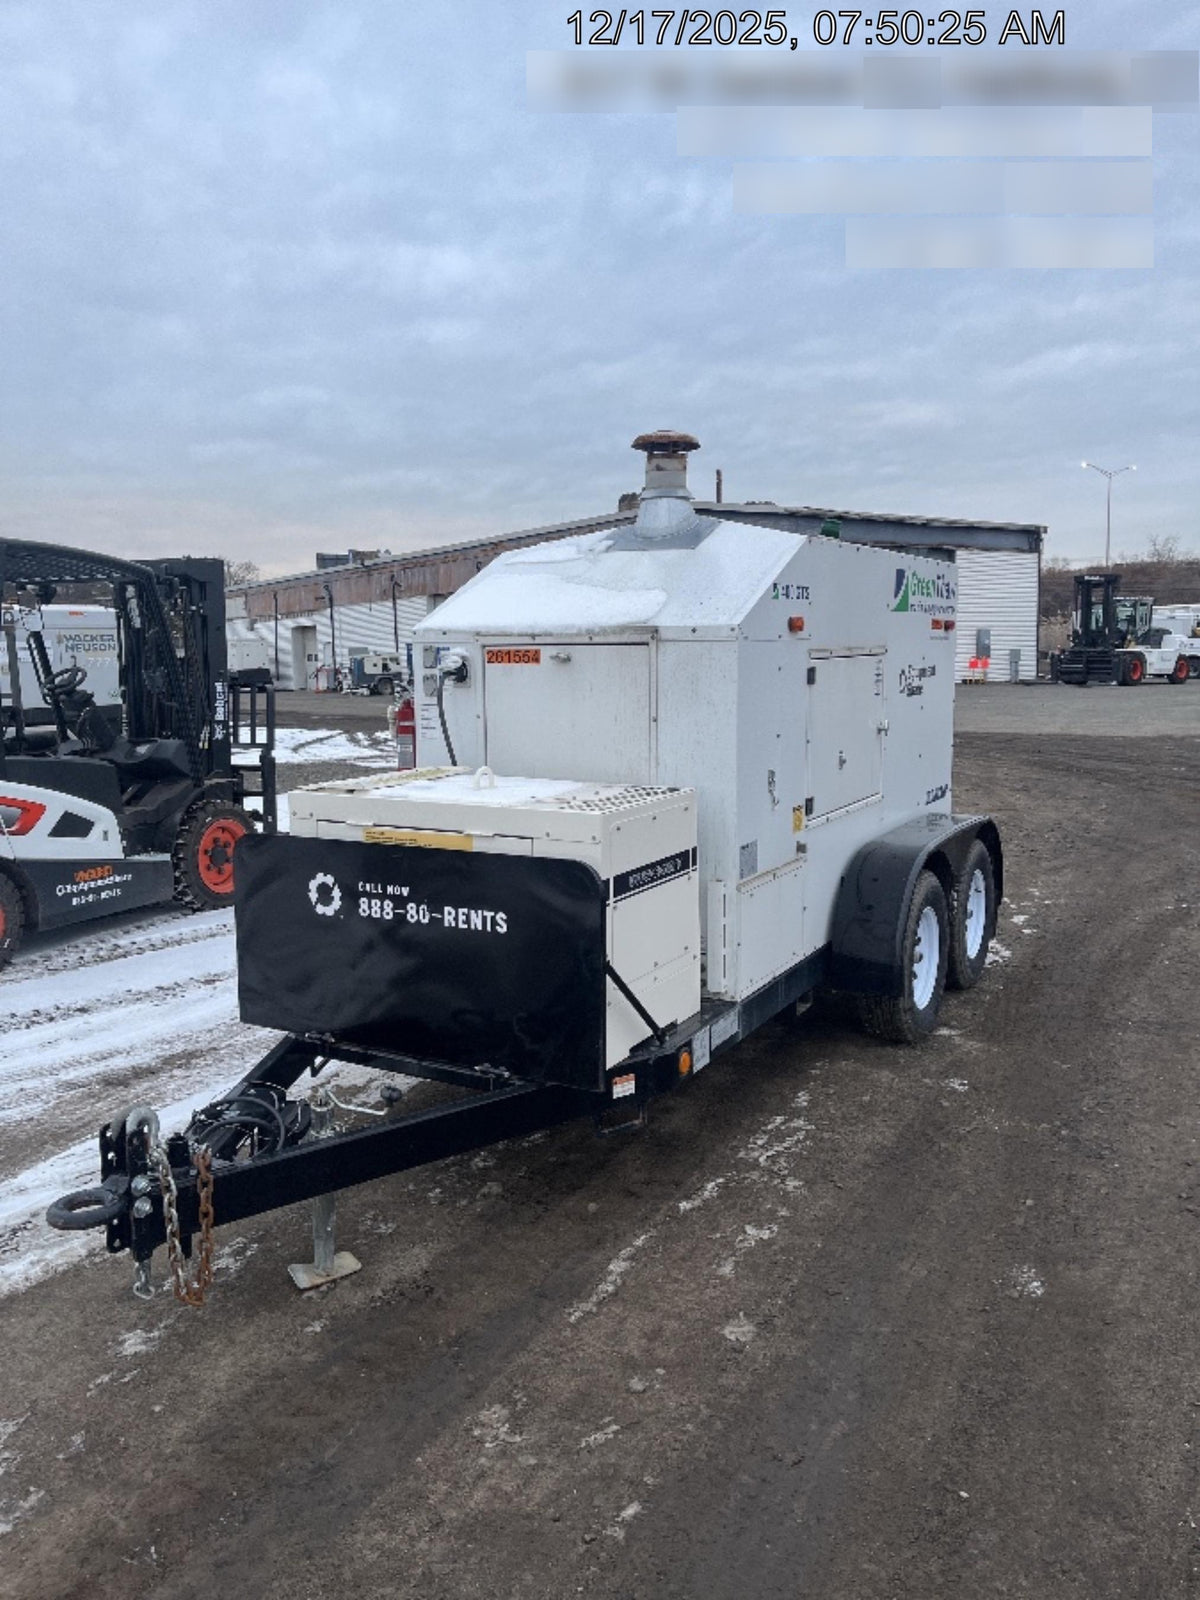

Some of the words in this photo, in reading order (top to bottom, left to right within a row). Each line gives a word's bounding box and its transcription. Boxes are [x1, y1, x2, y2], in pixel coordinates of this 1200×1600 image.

[63, 634, 115, 643] WACKER
[64, 643, 116, 653] NEUSON
[358, 881, 383, 893] CALL
[386, 884, 409, 897] NOW
[358, 897, 508, 934] 888-80-RENTS
